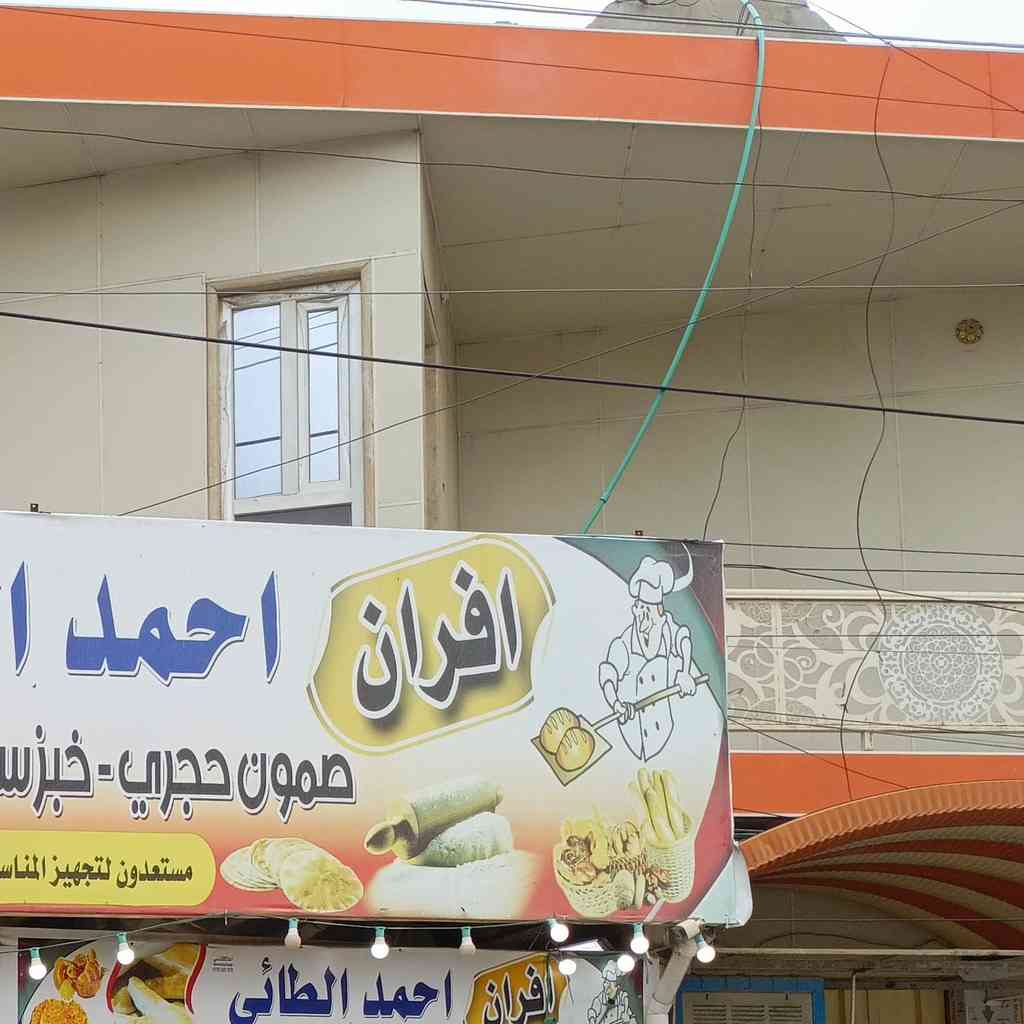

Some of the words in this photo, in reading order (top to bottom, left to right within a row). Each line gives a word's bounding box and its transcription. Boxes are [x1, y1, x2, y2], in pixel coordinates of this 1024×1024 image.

[65, 570, 280, 687] احمد
[355, 563, 521, 718] افران
[118, 748, 232, 820] حجري
[237, 752, 356, 823] صمون
[50, 855, 112, 888] لتجهيز
[116, 856, 193, 889] مستعدون
[362, 968, 454, 1024] احمد
